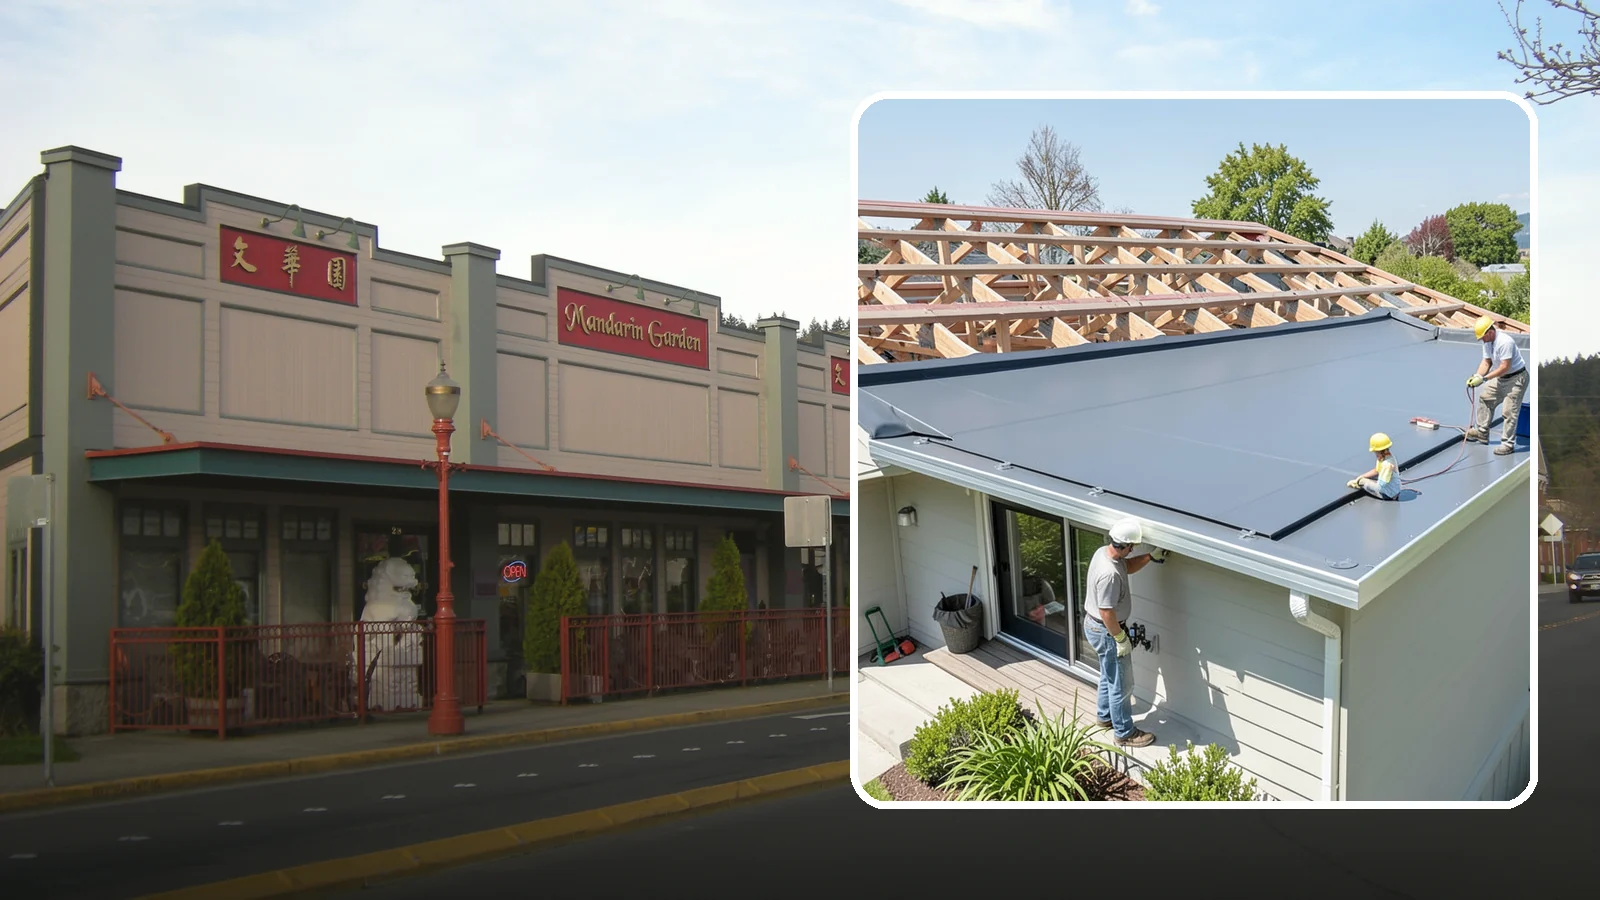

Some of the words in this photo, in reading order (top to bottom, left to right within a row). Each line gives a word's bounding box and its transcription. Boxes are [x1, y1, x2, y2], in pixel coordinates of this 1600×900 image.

[565, 302, 643, 340] Mandarin
[648, 320, 701, 352] Garden
[503, 565, 527, 578] OPEN
